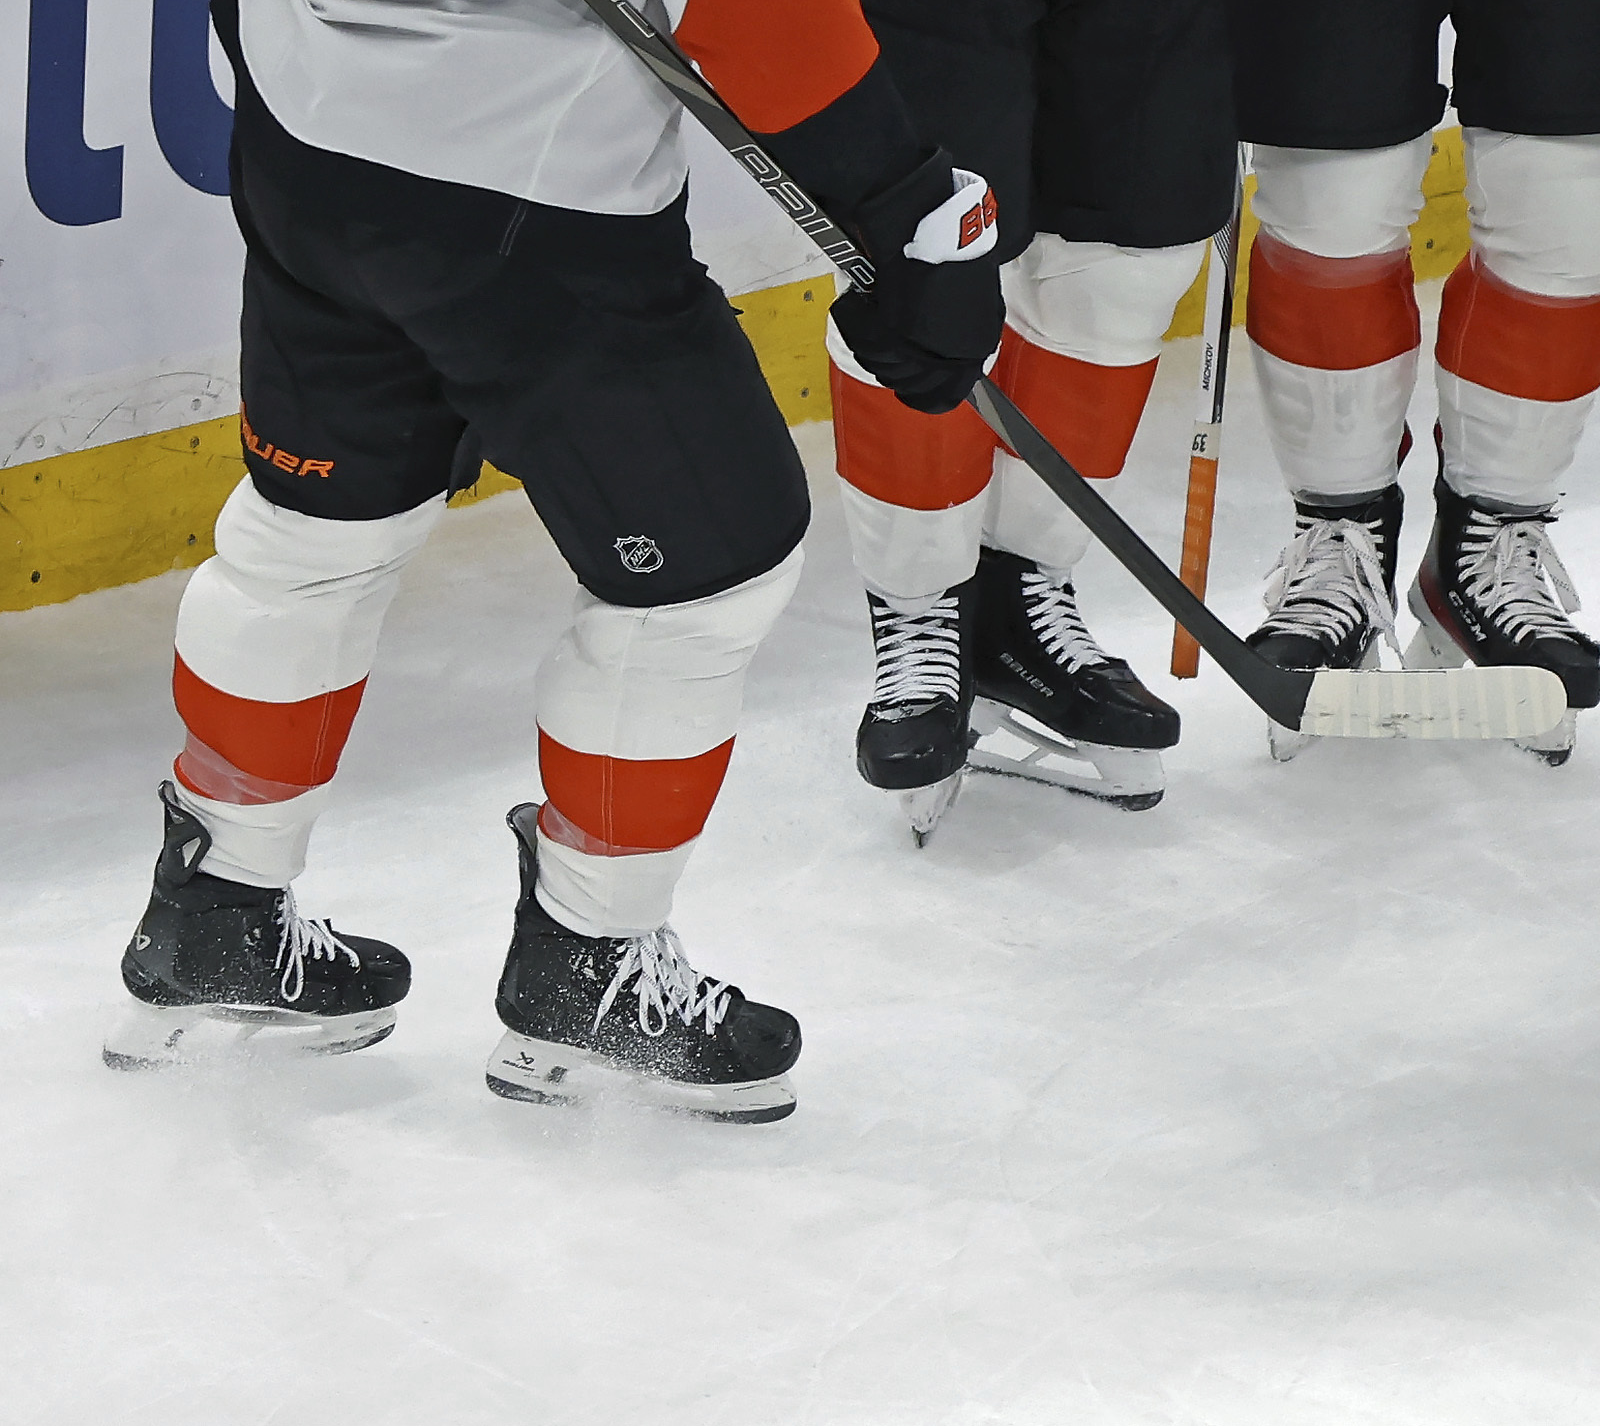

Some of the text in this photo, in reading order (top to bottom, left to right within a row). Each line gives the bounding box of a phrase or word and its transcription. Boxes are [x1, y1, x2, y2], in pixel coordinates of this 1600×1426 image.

[1202, 342, 1214, 391] MICHKOV
[1192, 433, 1208, 453] 39
[1448, 589, 1488, 643] CCM
[1000, 652, 1054, 697] BAUER
